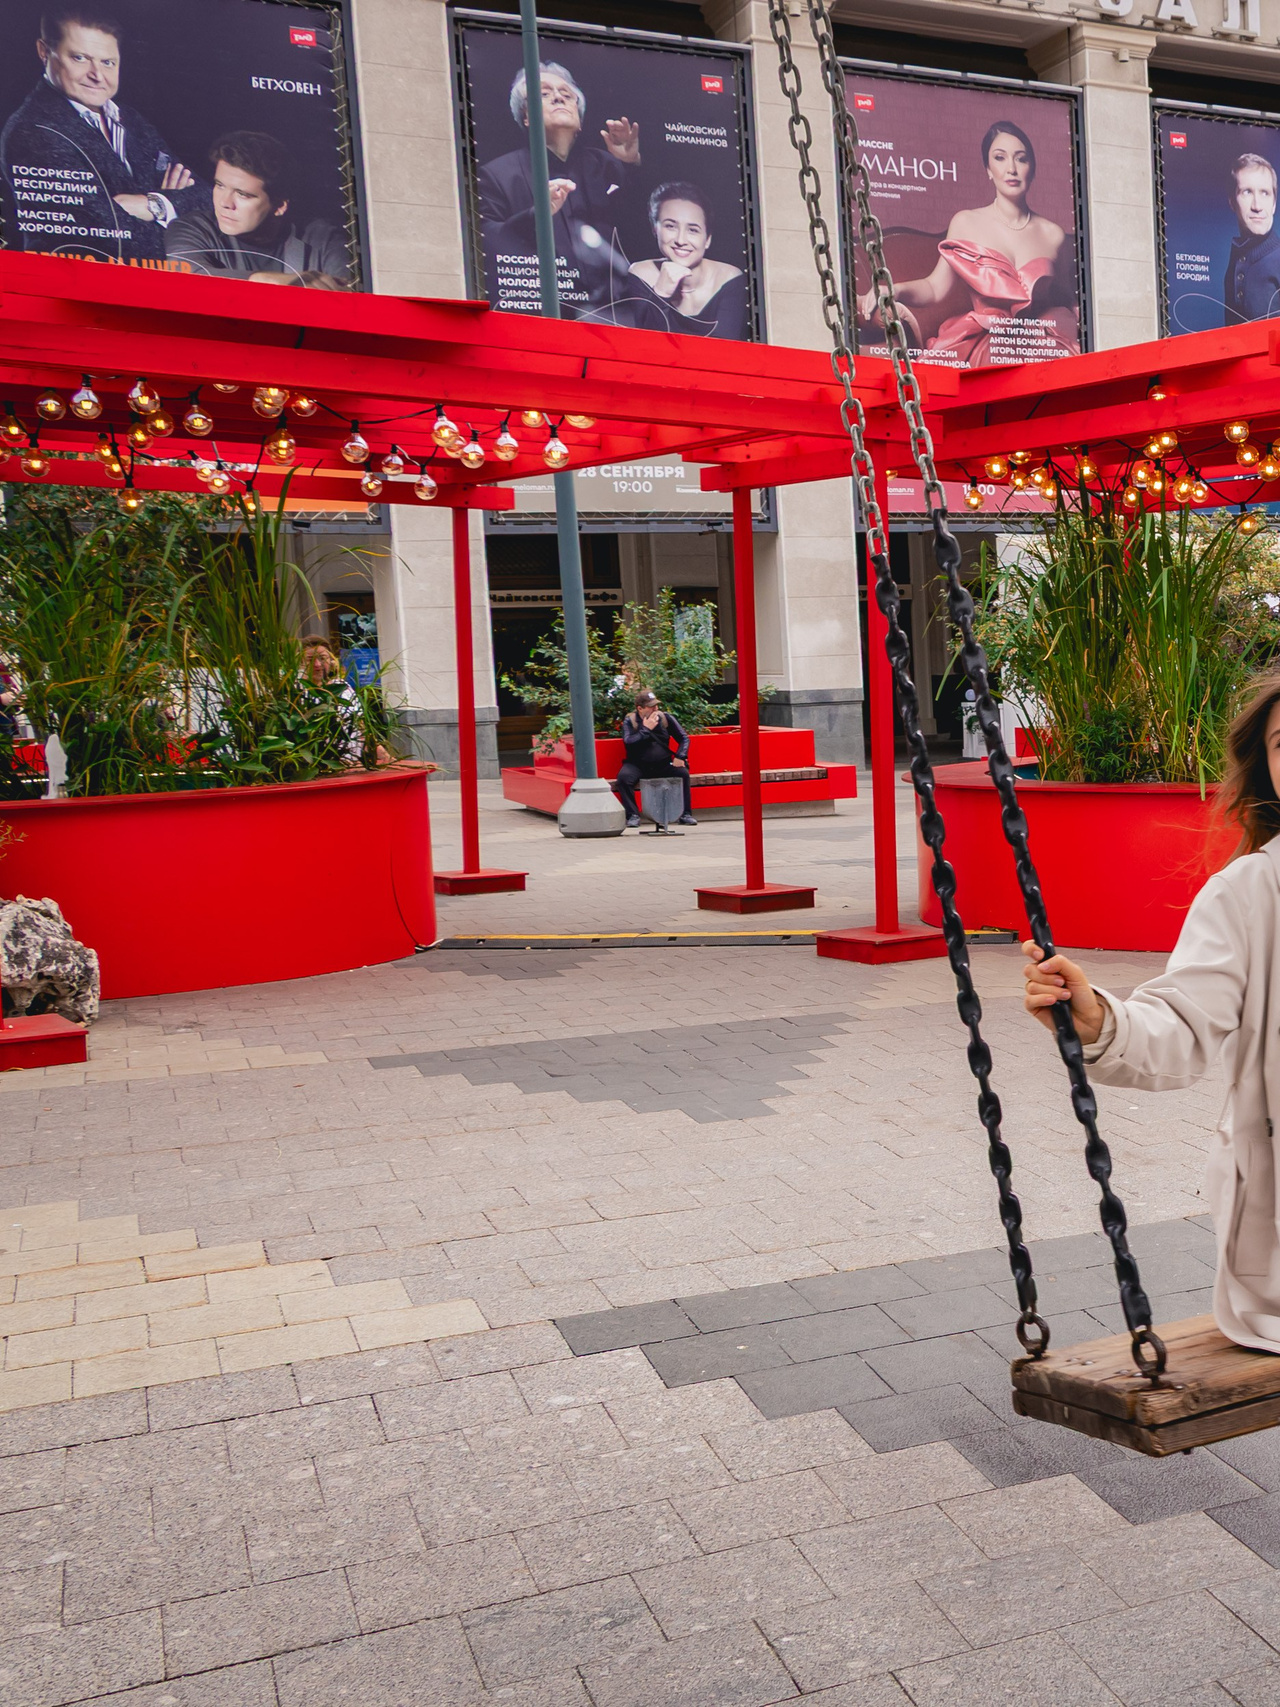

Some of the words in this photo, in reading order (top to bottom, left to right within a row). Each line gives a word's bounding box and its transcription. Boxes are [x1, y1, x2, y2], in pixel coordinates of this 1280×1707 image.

[251, 76, 322, 96] БЕТХОВЕН
[664, 122, 727, 137] ЧАЙКОВСКИЙ
[665, 133, 728, 148] РАХМАНИНОВ
[858, 139, 894, 150] МАССНЕ
[12, 165, 94, 181] ГОСОРКЕСТР
[860, 153, 957, 181] МАНОН
[13, 178, 98, 194] РЕСПУБЛИКИ
[14, 191, 84, 206] ТАТАРСТАН
[17, 209, 76, 222] МАСТЕРА
[18, 222, 88, 236] ХОРОВОГО
[90, 227, 132, 239] ПЕНИЯ
[496, 254, 567, 267] РОССИЙИЙ
[1175, 253, 1210, 263] БЕТХОВЕН
[497, 266, 580, 278] НАЦИОННЫЙ
[1176, 262, 1209, 272] ГОЛОВИН
[498, 277, 574, 289] МОЛОДЁЫЙ
[1176, 272, 1210, 282] БОРОДИН
[498, 289, 589, 301] СИМФОНЕСКИЙ
[988, 317, 1023, 325] МАКСИМ
[989, 325, 1006, 334] АЙК
[1006, 327, 1045, 336] ТИГРАНЯН
[989, 336, 1016, 345] АНТОН
[923, 349, 958, 358] РОССИИ
[989, 346, 1016, 355] ИГОРЬ
[1016, 348, 1069, 357] ПОДОПЛЕЛОВ
[990, 356, 1023, 364] ПОЛИНА
[577, 466, 597, 478] 28
[600, 465, 685, 478] СЕНТЯБРЯ
[612, 480, 653, 493] 19:00
[489, 593, 563, 602] Чайковски
